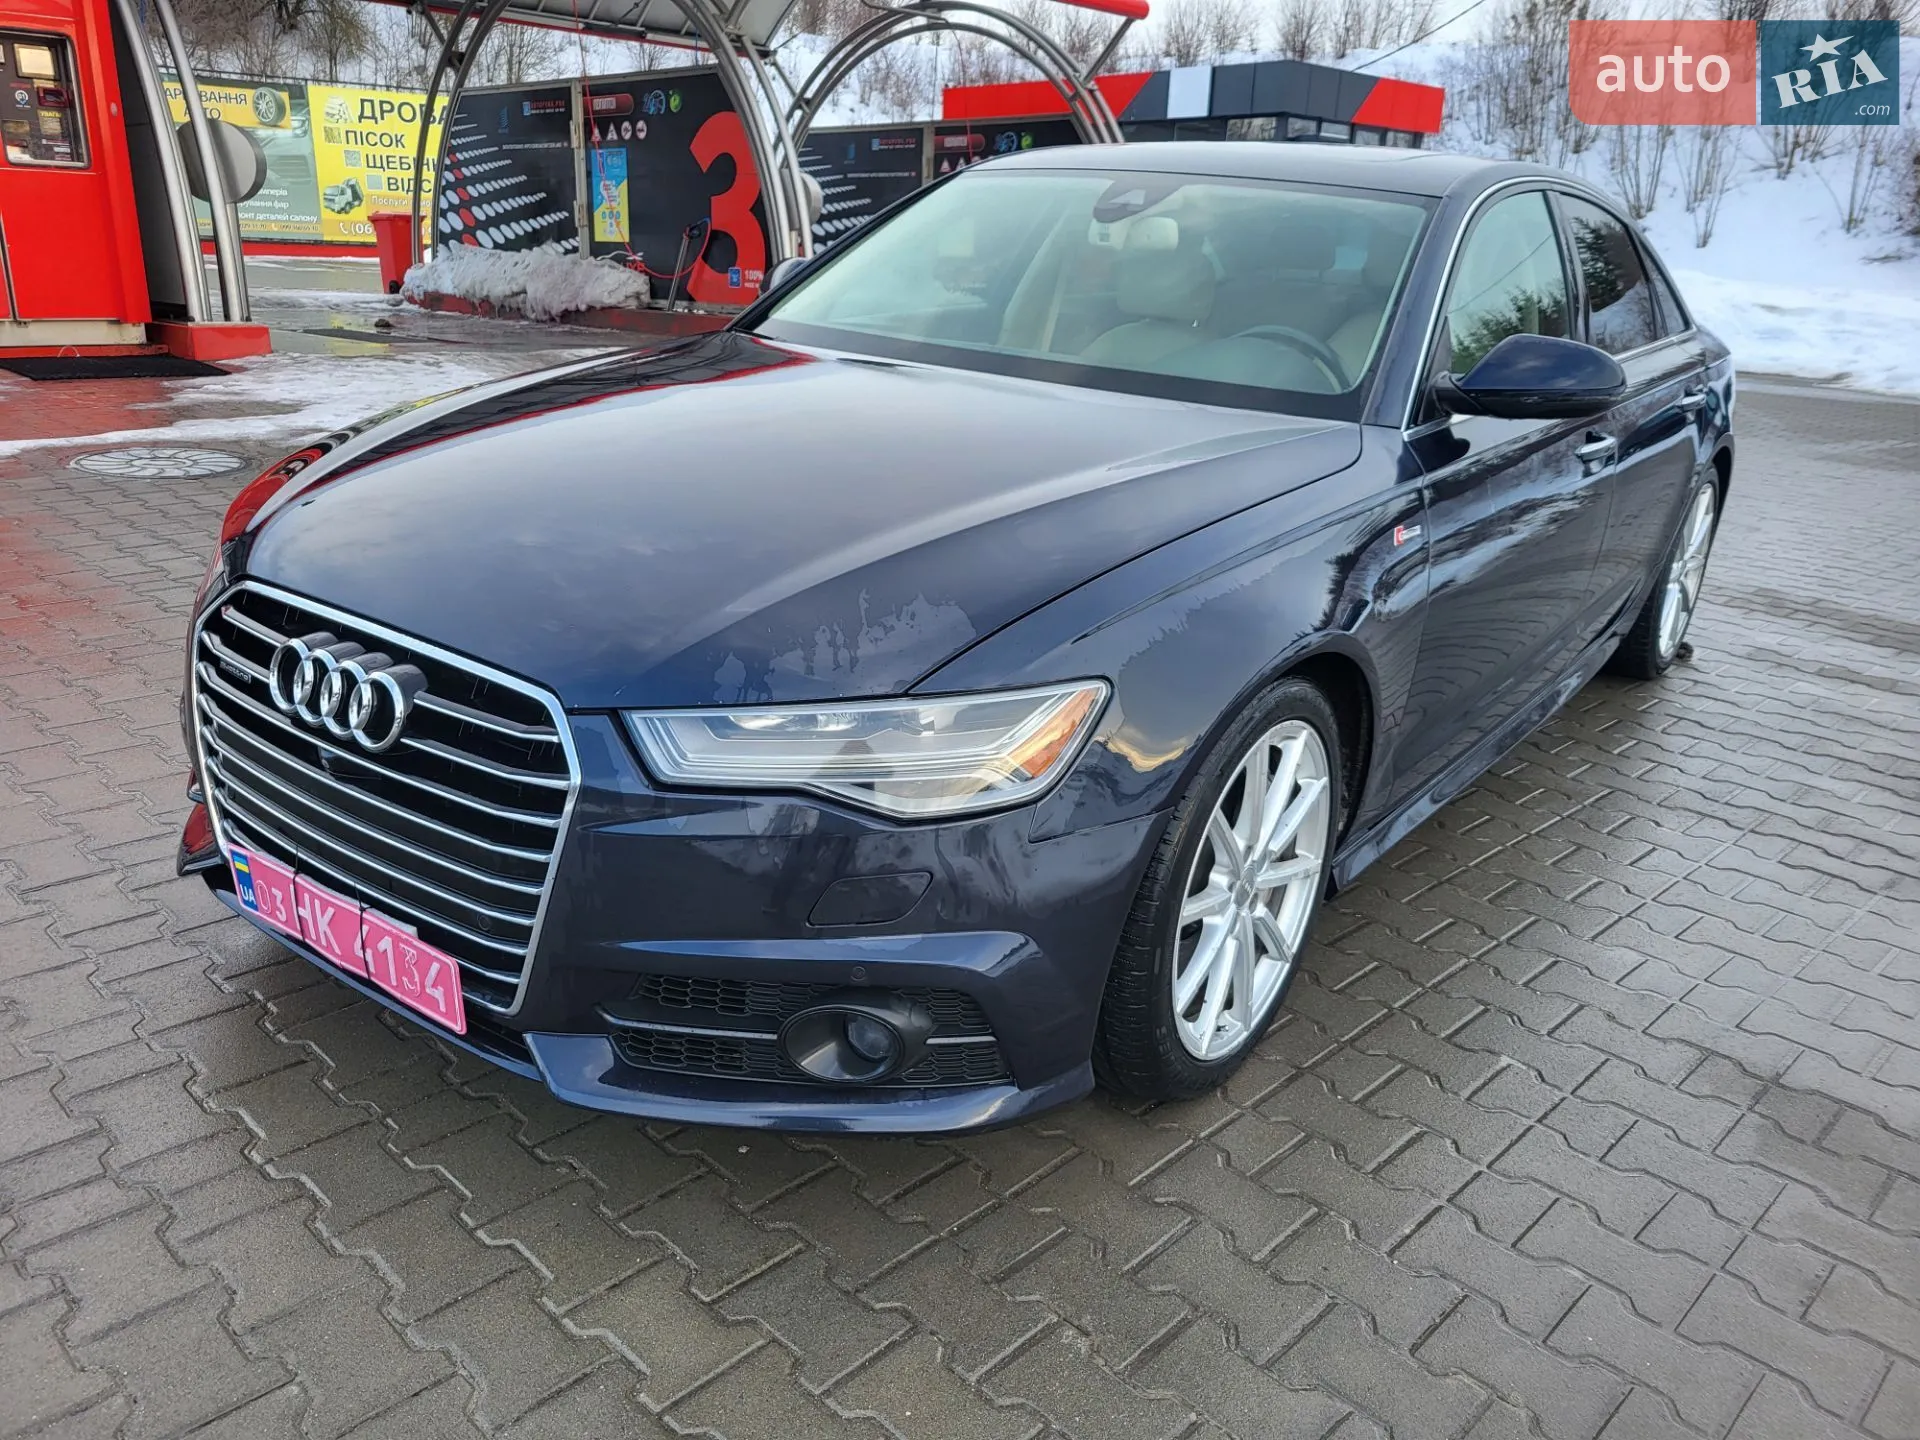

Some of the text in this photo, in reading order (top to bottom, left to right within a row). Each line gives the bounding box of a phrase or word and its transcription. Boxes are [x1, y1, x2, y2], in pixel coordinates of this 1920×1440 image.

[345, 129, 405, 149] ПІСОК
[687, 111, 766, 306] 3
[240, 884, 257, 905] UA
[257, 880, 287, 922] 03
